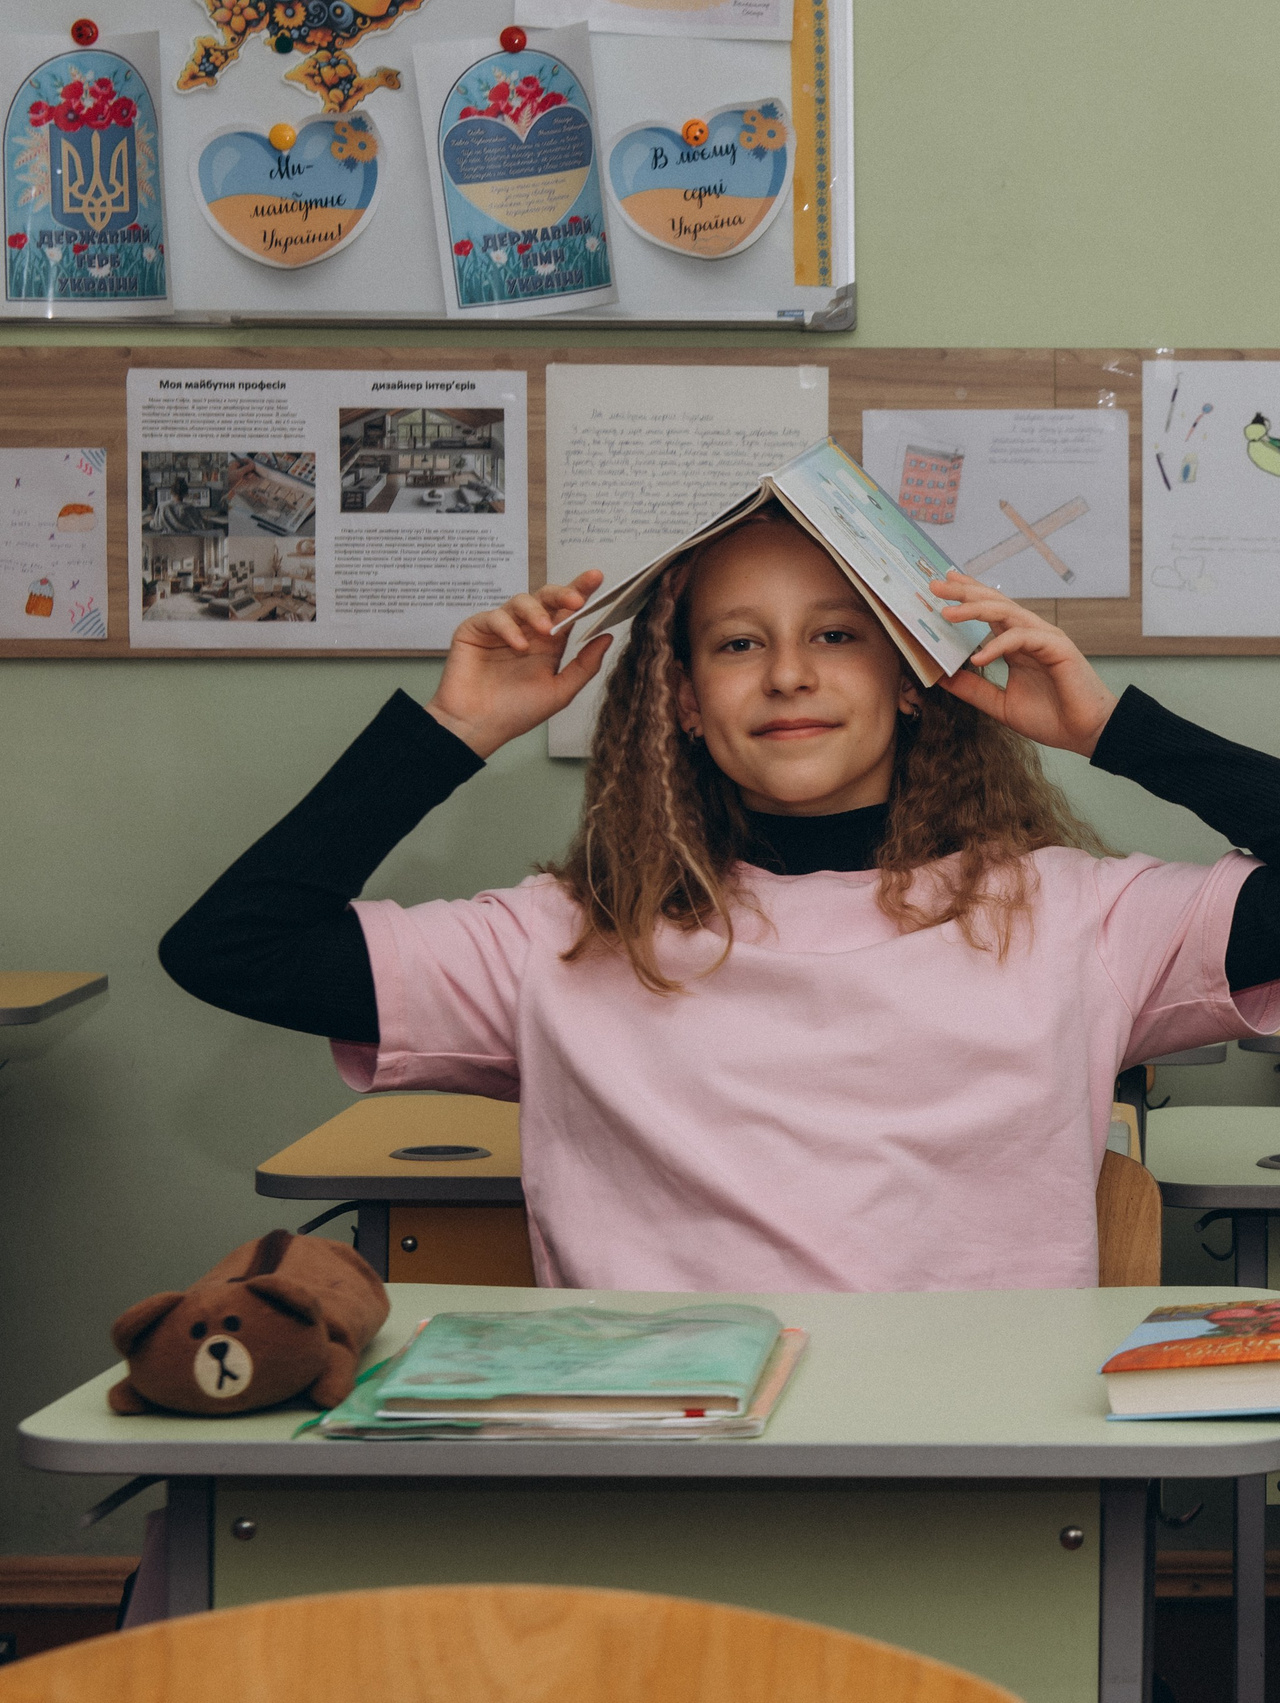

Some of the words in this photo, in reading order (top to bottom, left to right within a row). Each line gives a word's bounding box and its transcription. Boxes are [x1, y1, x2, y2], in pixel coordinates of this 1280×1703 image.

[651, 147, 669, 170] В
[676, 142, 737, 166] моєму
[250, 192, 346, 221] майбутнє
[684, 179, 727, 209] серці
[36, 224, 151, 249] ДЕРЖАВНИЙ
[262, 222, 342, 254] України!
[481, 215, 592, 253] ДЕРЖАВНИЙ
[668, 215, 745, 241] Україна
[76, 253, 121, 269] ГЕРБ
[521, 247, 565, 269] ГІМН
[58, 272, 138, 293] УКРАЇНИ
[506, 268, 584, 295] УКРАЇНИ
[159, 380, 182, 390] Моя
[184, 379, 235, 392] майбутня
[238, 380, 287, 392] професія
[371, 380, 423, 392] дизайнер
